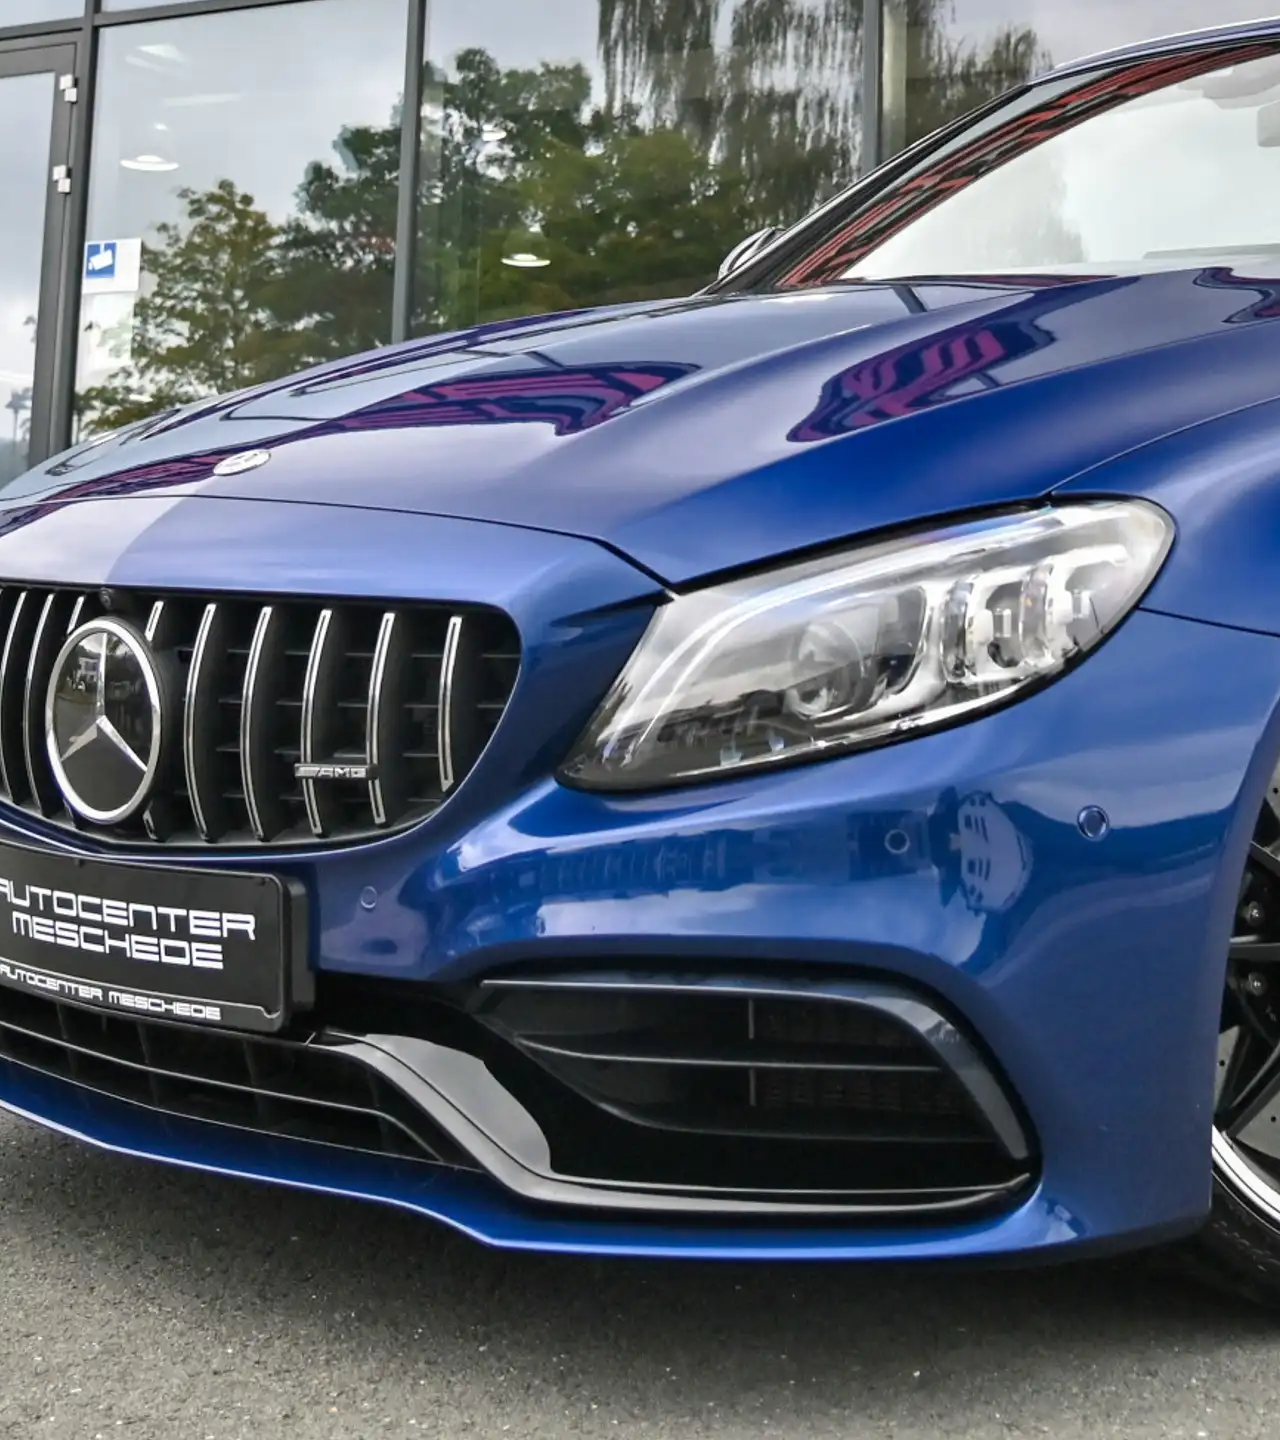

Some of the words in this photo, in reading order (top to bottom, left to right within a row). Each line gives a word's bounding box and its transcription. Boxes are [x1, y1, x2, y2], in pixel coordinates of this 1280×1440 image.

[317, 766, 367, 779] AMG
[11, 910, 225, 971] MESCHEDE
[108, 990, 222, 1021] MESCHEDE
